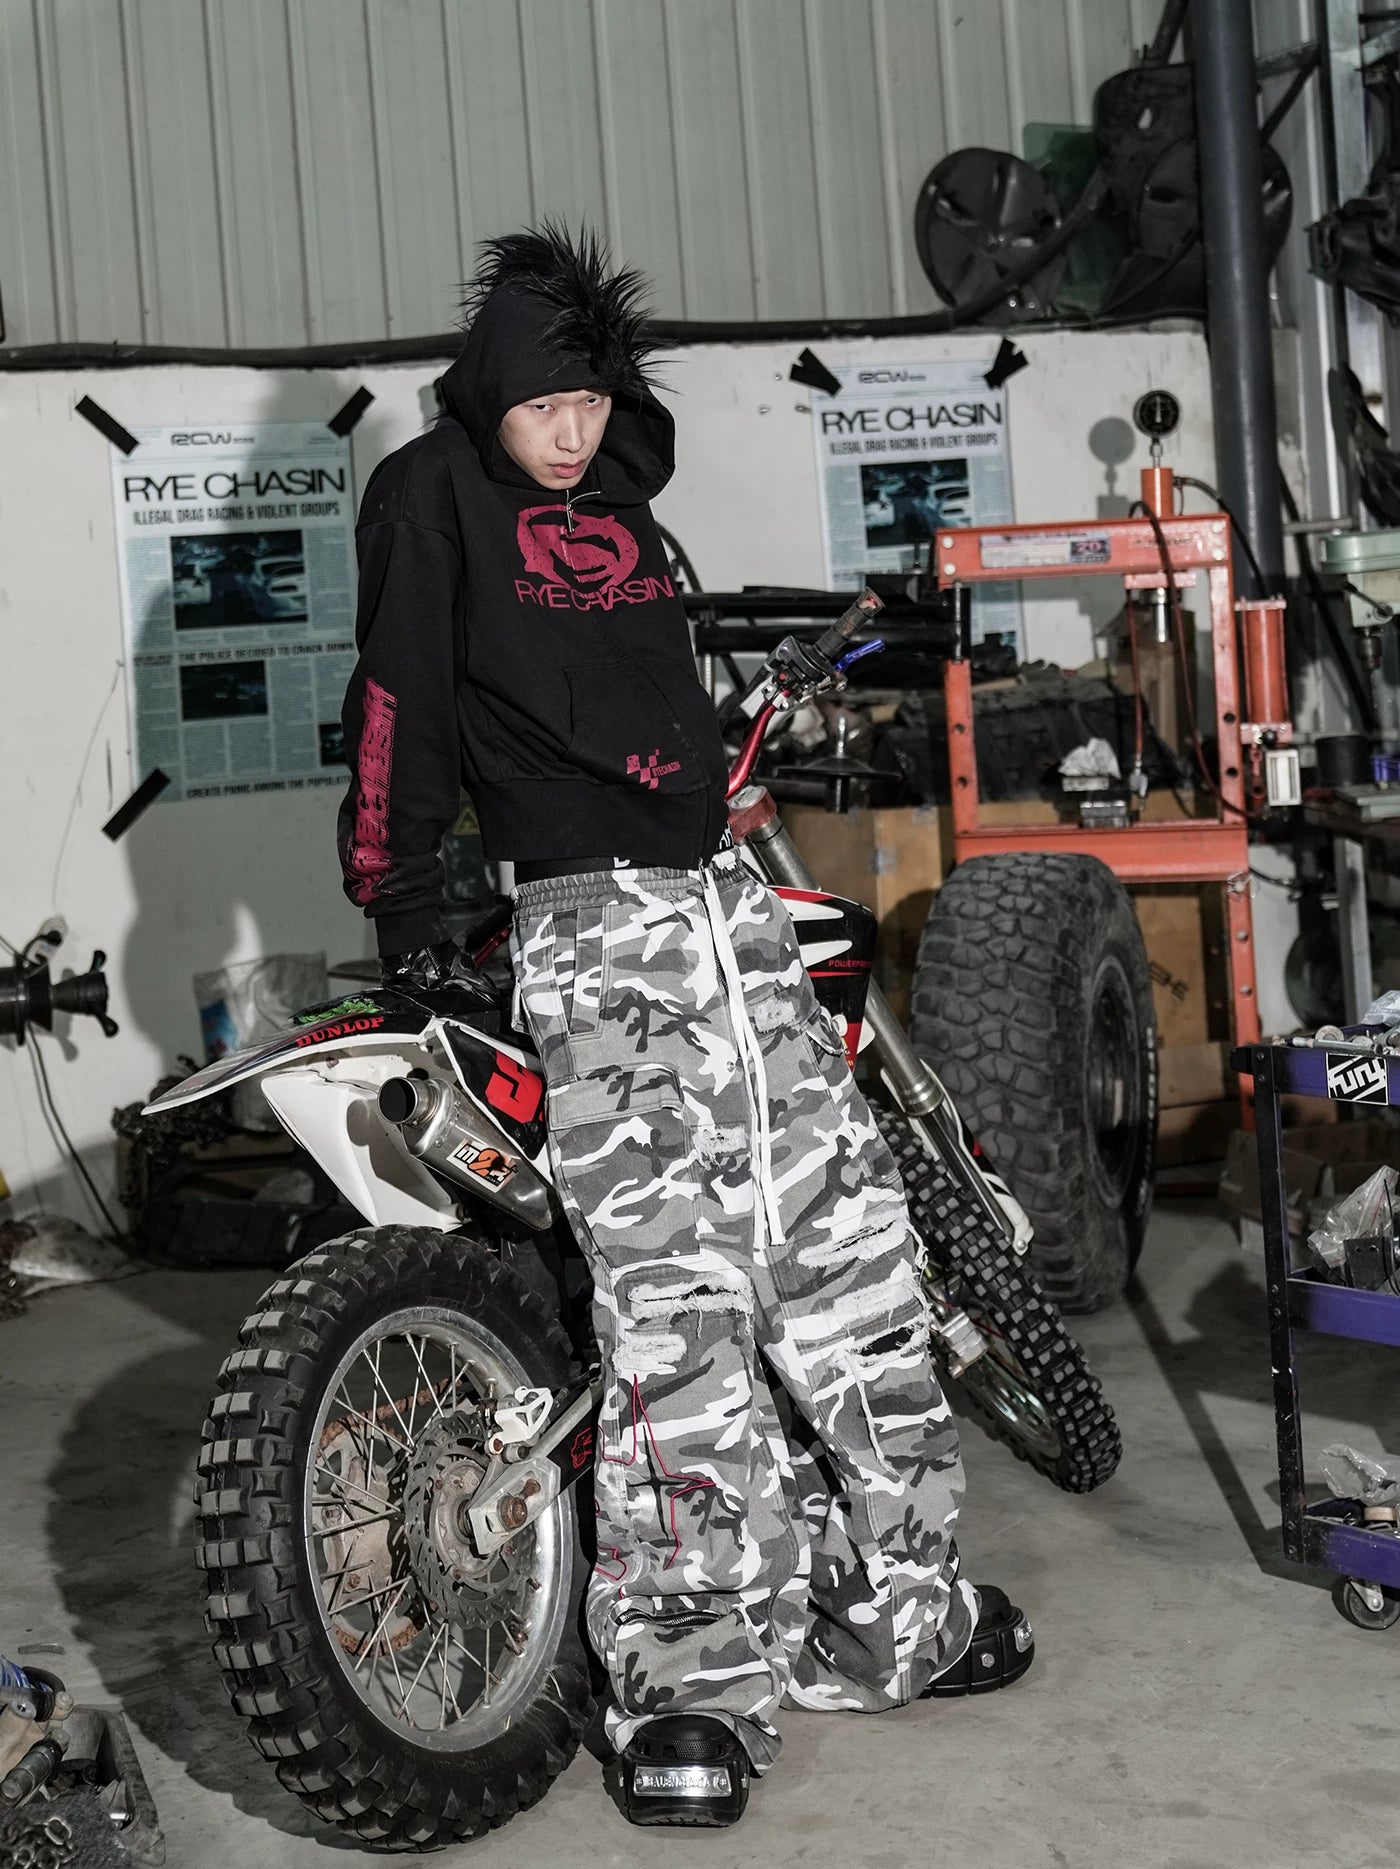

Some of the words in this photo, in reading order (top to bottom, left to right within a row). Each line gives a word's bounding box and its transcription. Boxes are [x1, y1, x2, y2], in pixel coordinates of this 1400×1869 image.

[821, 409, 881, 435] RYE
[886, 402, 1002, 431] CHASIN
[830, 441, 863, 455] ILLEGAL
[865, 439, 886, 452] DRAG
[890, 438, 919, 451] RACING
[930, 435, 963, 448] VIOLENT
[966, 433, 997, 446] GROUPS
[124, 474, 197, 502] RYE
[204, 467, 345, 499] CHASIN
[133, 509, 175, 525] ILLEGAL
[178, 508, 204, 523] DRAG
[207, 506, 245, 522] RACING
[246, 506, 254, 520] &
[257, 503, 297, 519] VIOLENT
[301, 501, 340, 517] GROUPS
[514, 579, 571, 609] RYE
[296, 1015, 385, 1047] DUNLOP
